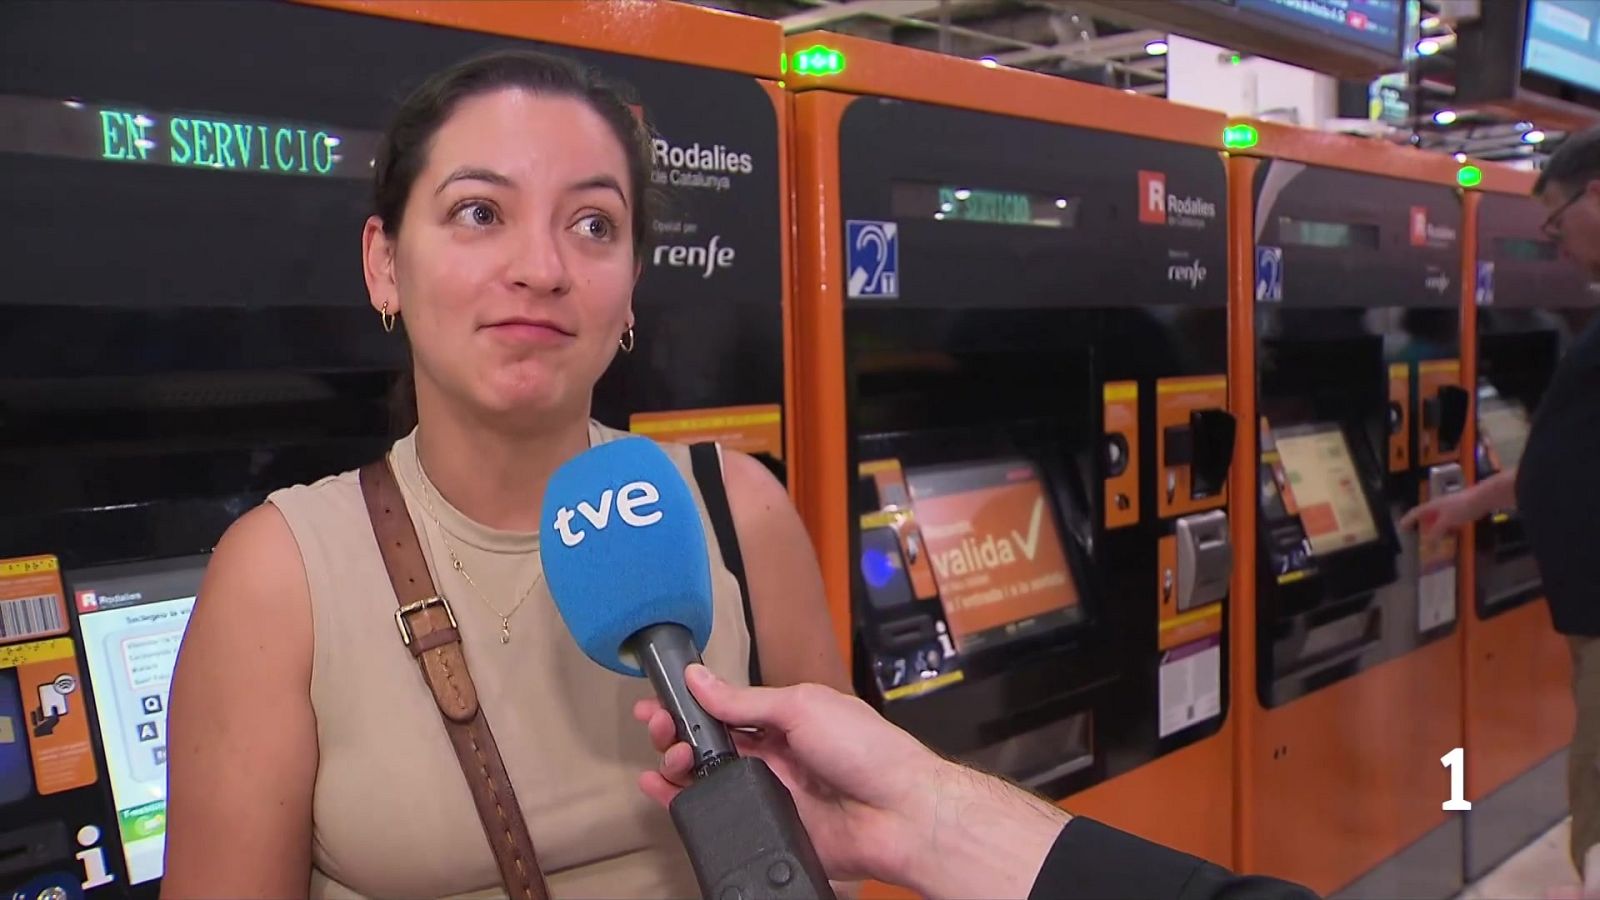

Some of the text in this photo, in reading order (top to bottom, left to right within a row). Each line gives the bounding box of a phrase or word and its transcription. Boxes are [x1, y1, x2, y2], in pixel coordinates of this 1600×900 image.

[100, 110, 332, 173] EN SERVICIO
[652, 139, 753, 174] Rodalies
[669, 169, 731, 191] Catalunya
[1148, 180, 1216, 218] R Rodalies
[653, 235, 736, 279] renfe
[1168, 259, 1207, 289] renfe
[553, 481, 663, 547] tve
[931, 534, 1017, 578] valida
